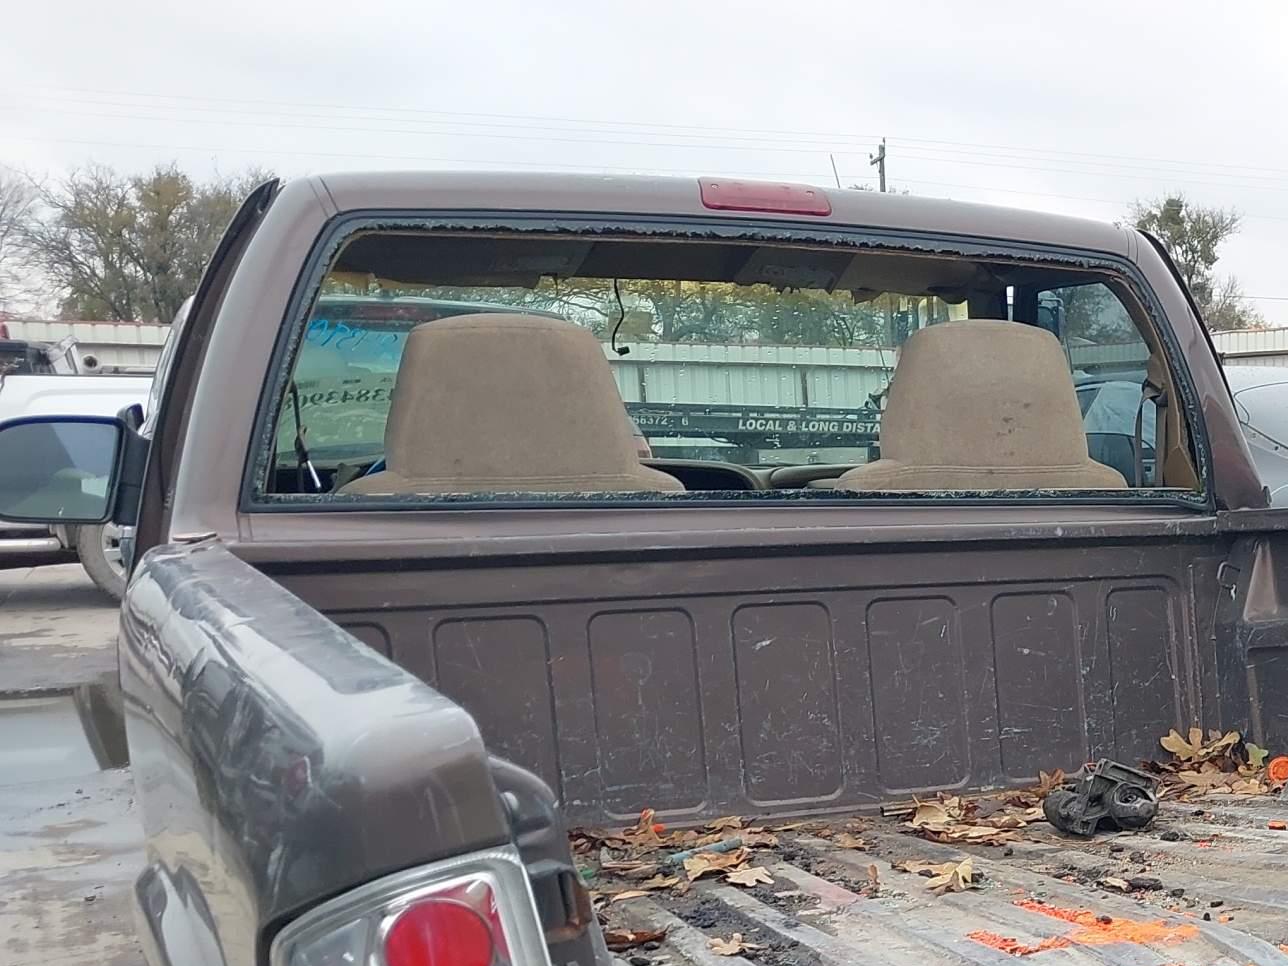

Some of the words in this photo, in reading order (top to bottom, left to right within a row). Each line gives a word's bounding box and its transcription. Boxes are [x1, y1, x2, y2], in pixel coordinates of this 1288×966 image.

[738, 419, 783, 431] LOCAL
[787, 420, 797, 431] &
[801, 421, 838, 432] LONG
